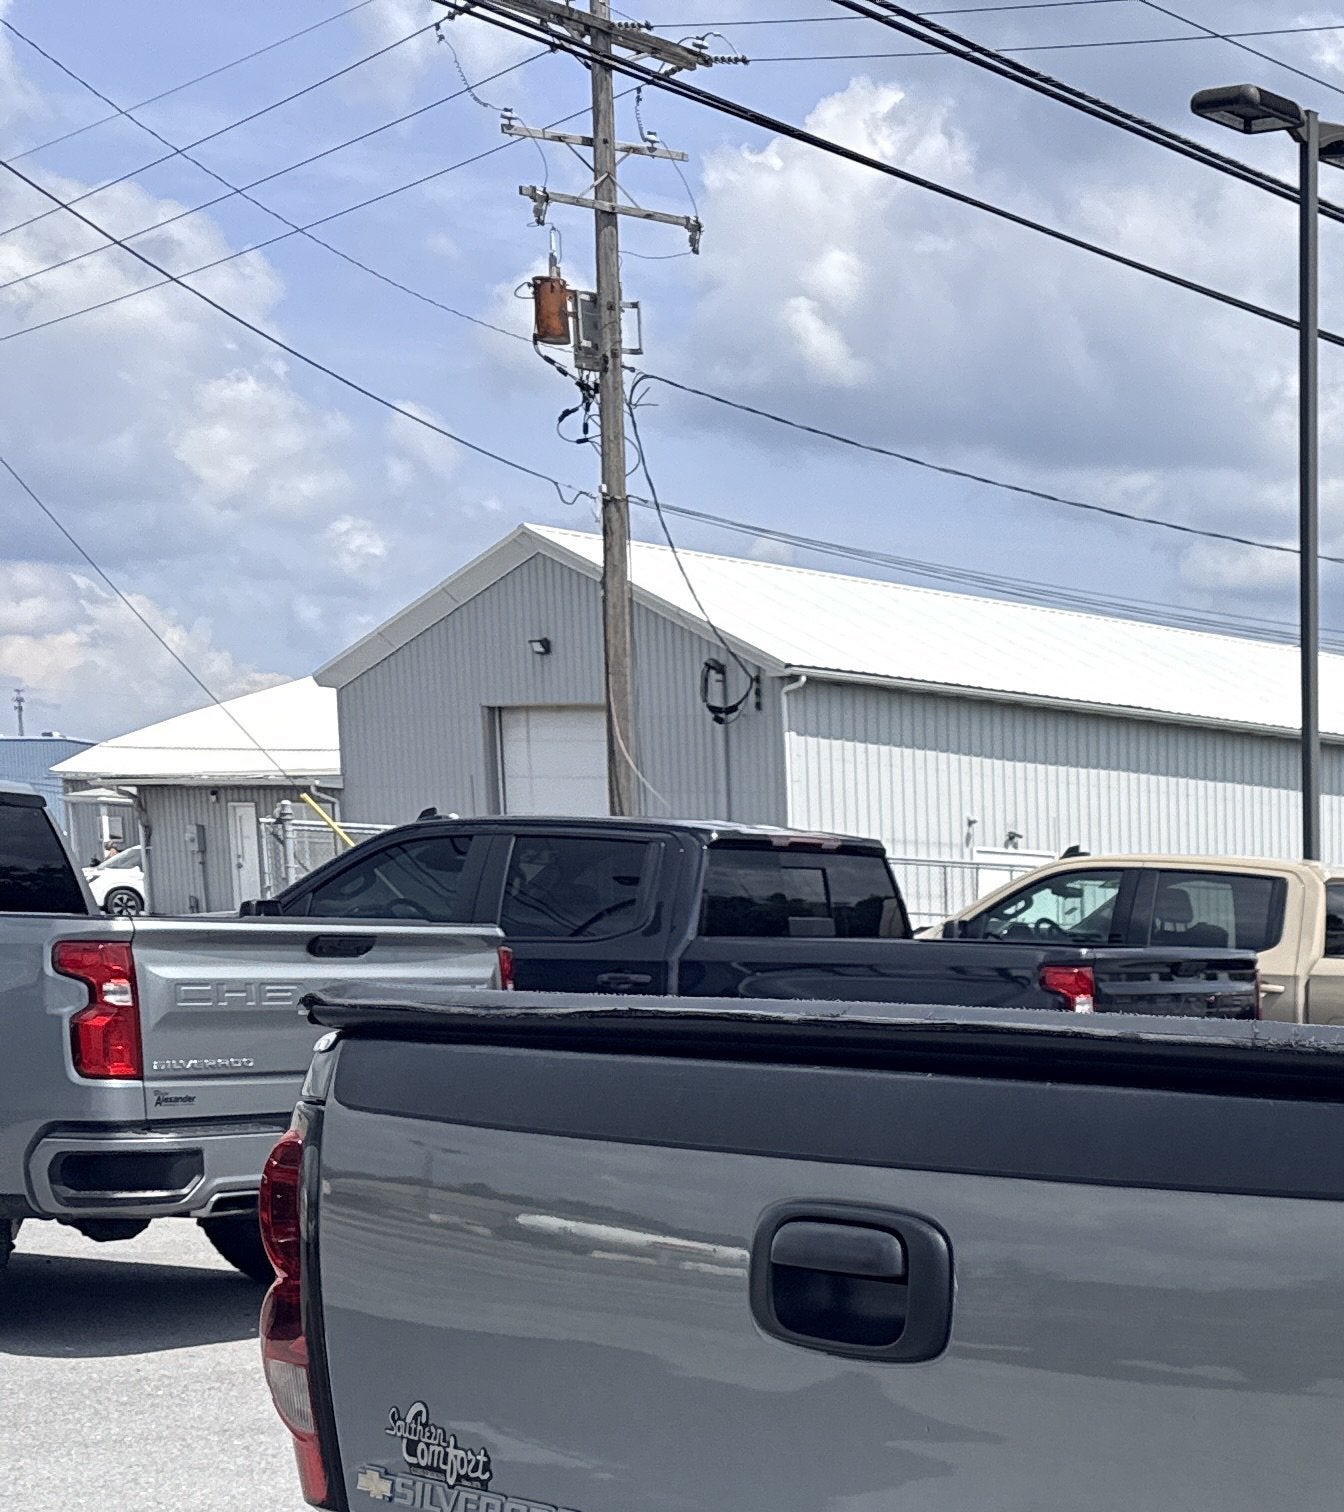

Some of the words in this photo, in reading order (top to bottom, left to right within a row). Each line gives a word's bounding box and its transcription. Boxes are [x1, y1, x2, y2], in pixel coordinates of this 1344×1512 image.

[152, 1057, 254, 1070] SILVERADO
[384, 1406, 448, 1447] Southern
[402, 1401, 492, 1487] Comfort
